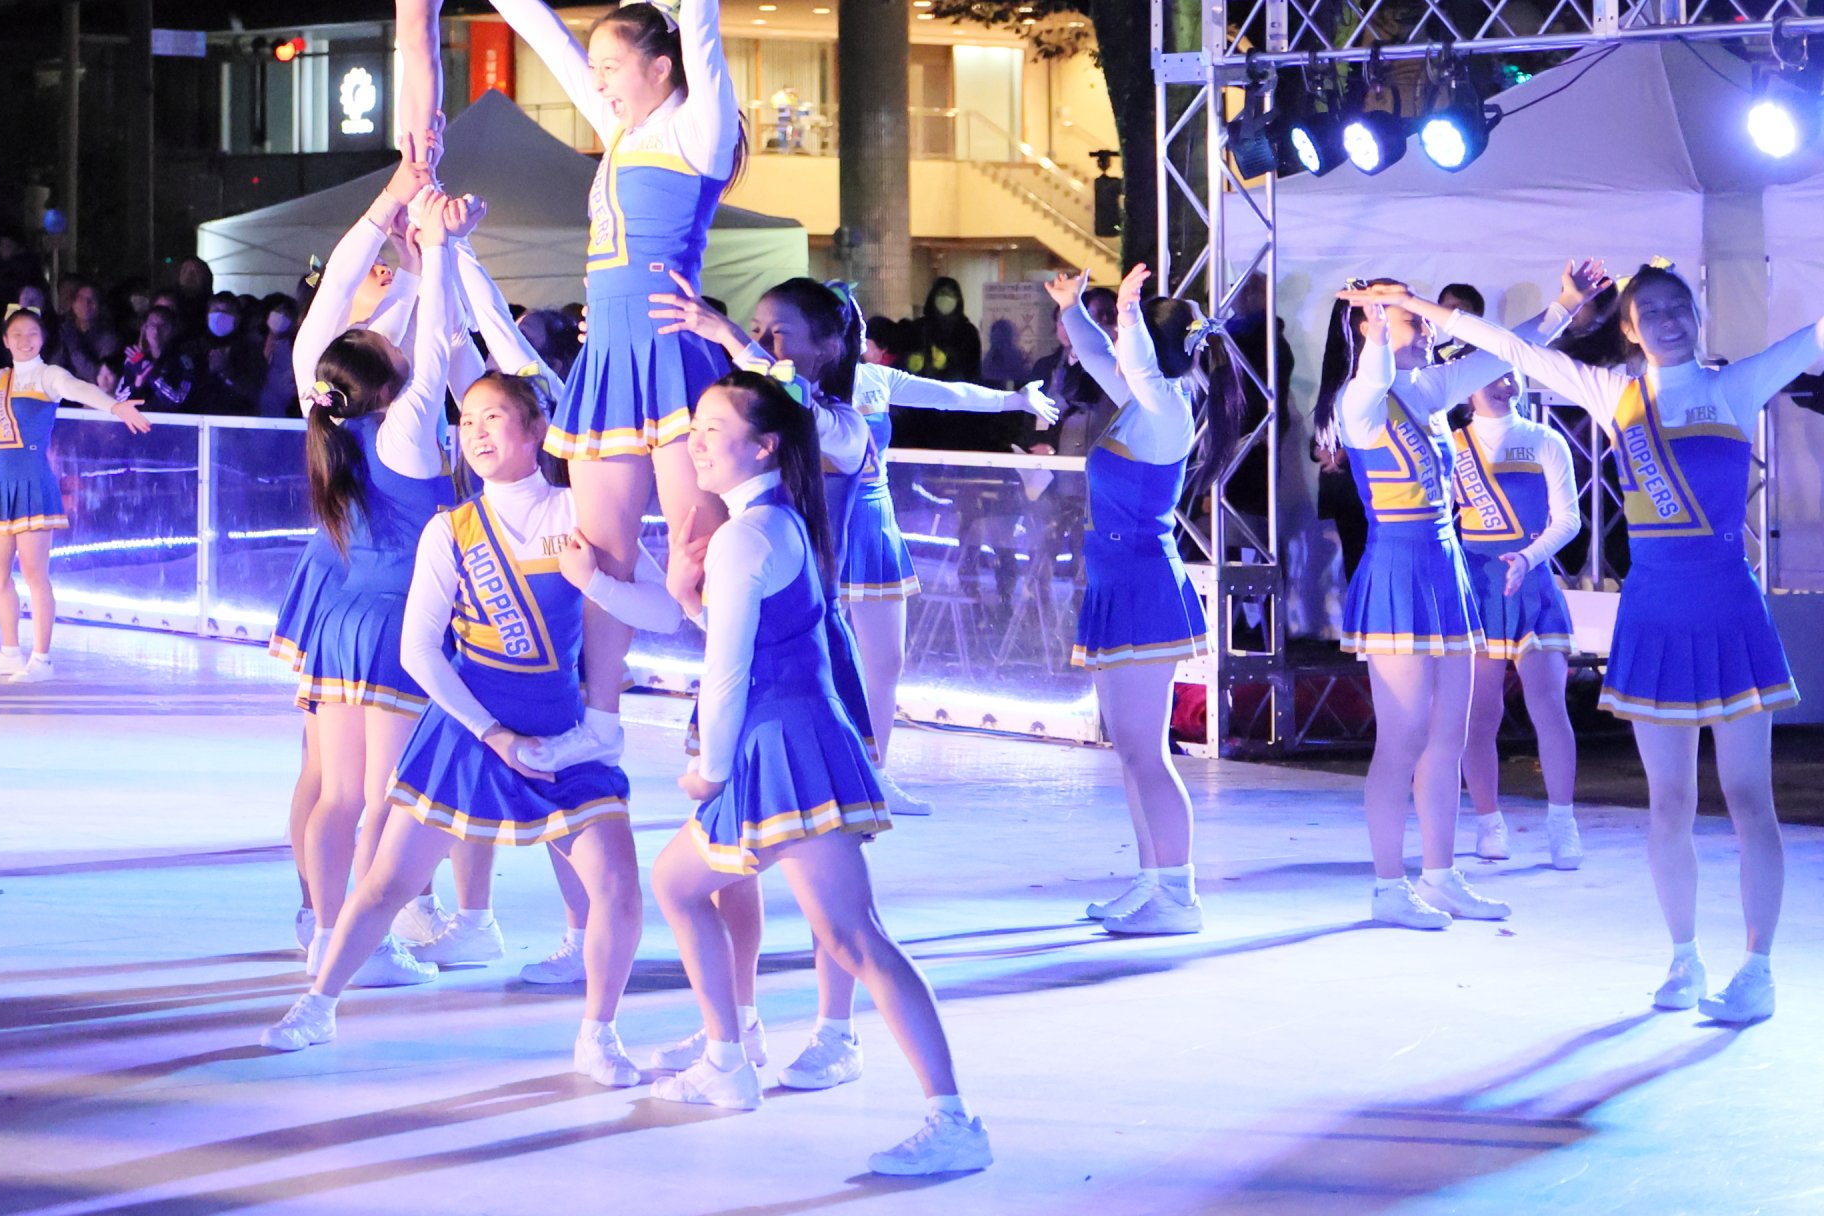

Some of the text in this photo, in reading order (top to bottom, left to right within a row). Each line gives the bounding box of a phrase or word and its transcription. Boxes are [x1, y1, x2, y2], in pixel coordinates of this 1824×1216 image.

[1504, 447, 1536, 462] MHS
[1684, 405, 1717, 423] MHS
[1398, 421, 1438, 502] HOPPERS
[1456, 448, 1502, 530] HOPPERS
[1624, 424, 1680, 519] HOPPERS
[540, 533, 573, 556] MH
[463, 542, 532, 658] HOPPERS
